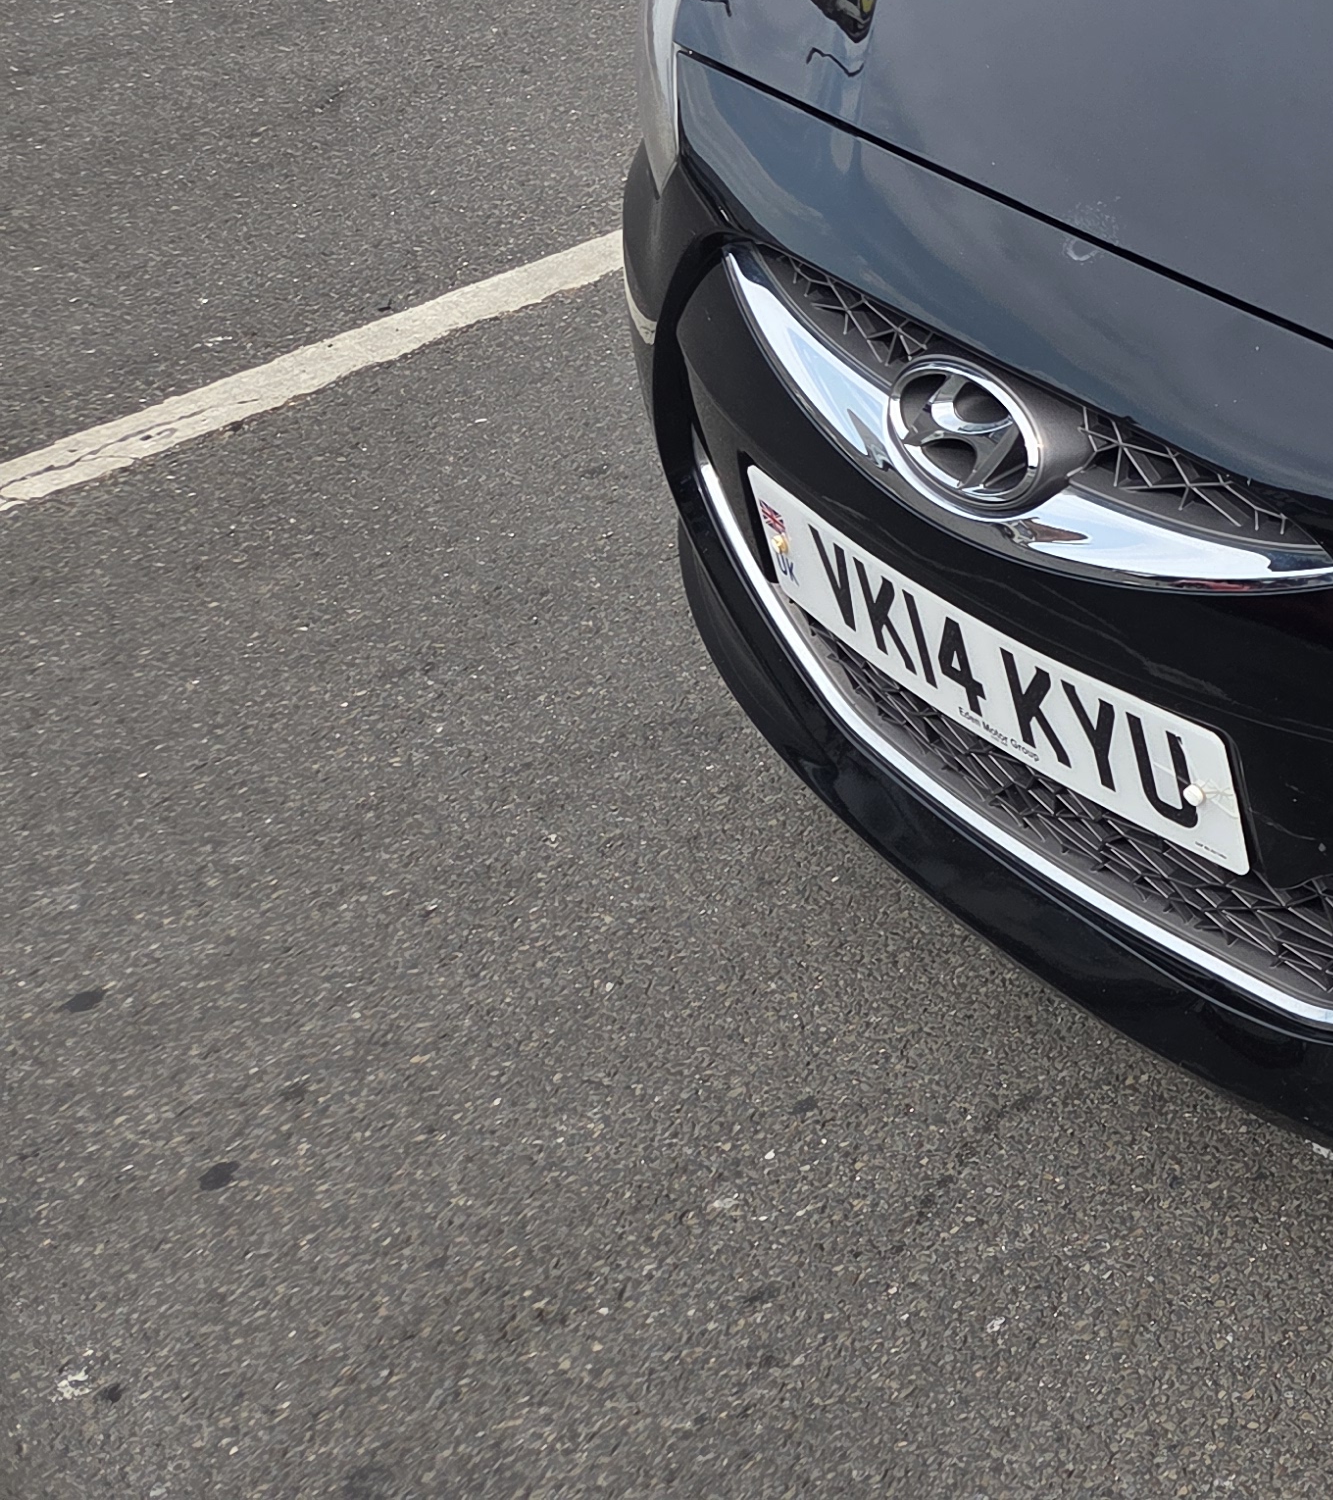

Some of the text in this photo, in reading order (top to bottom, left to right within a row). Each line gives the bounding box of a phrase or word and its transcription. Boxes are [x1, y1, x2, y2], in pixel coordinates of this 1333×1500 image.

[776, 554, 799, 587] UK
[807, 522, 1199, 829] VK14 KYU
[958, 706, 982, 727] Eden
[981, 720, 1008, 742] Motor
[1010, 738, 1040, 762] Group
